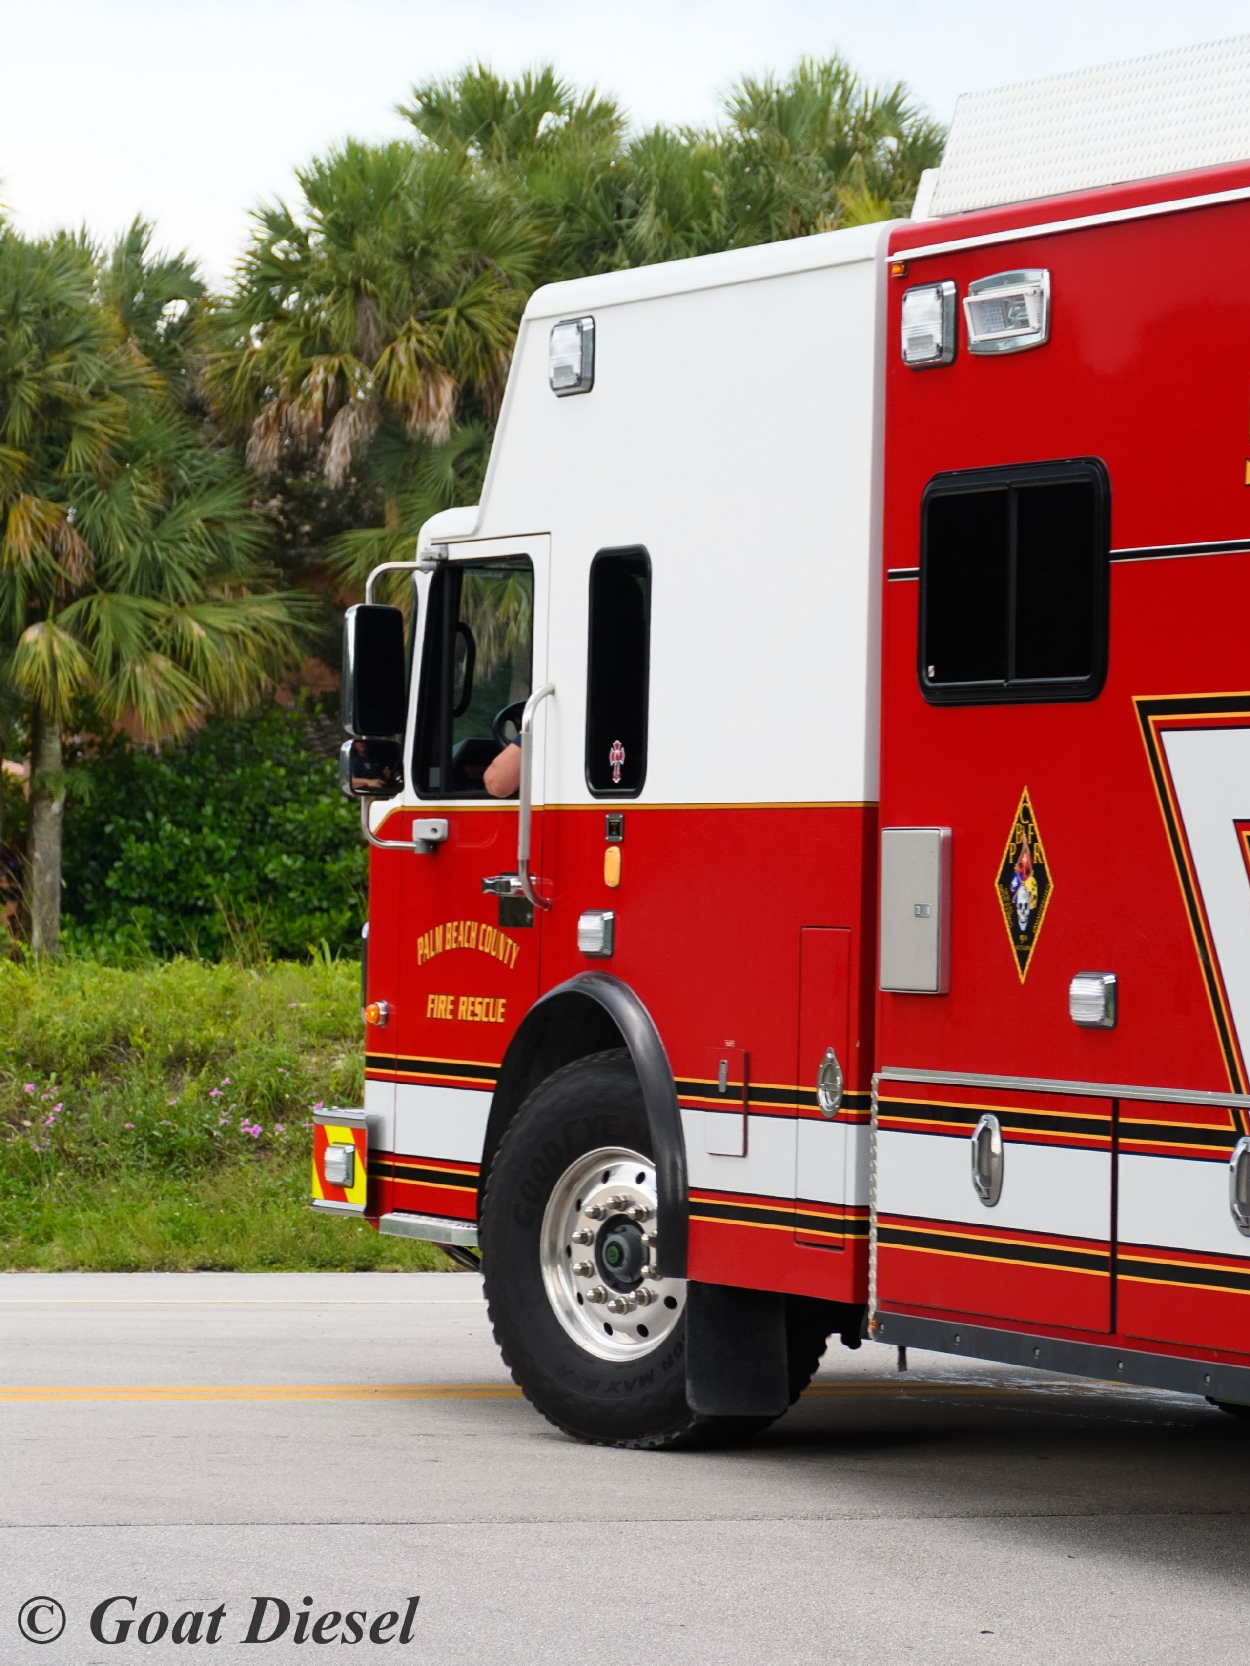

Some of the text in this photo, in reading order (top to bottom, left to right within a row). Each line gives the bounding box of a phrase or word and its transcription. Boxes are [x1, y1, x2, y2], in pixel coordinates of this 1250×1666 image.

[416, 920, 521, 970] PALM BEACH COUNTY
[426, 994, 507, 1023] FIRE RESCUE
[512, 1114, 647, 1228] GOODYEA
